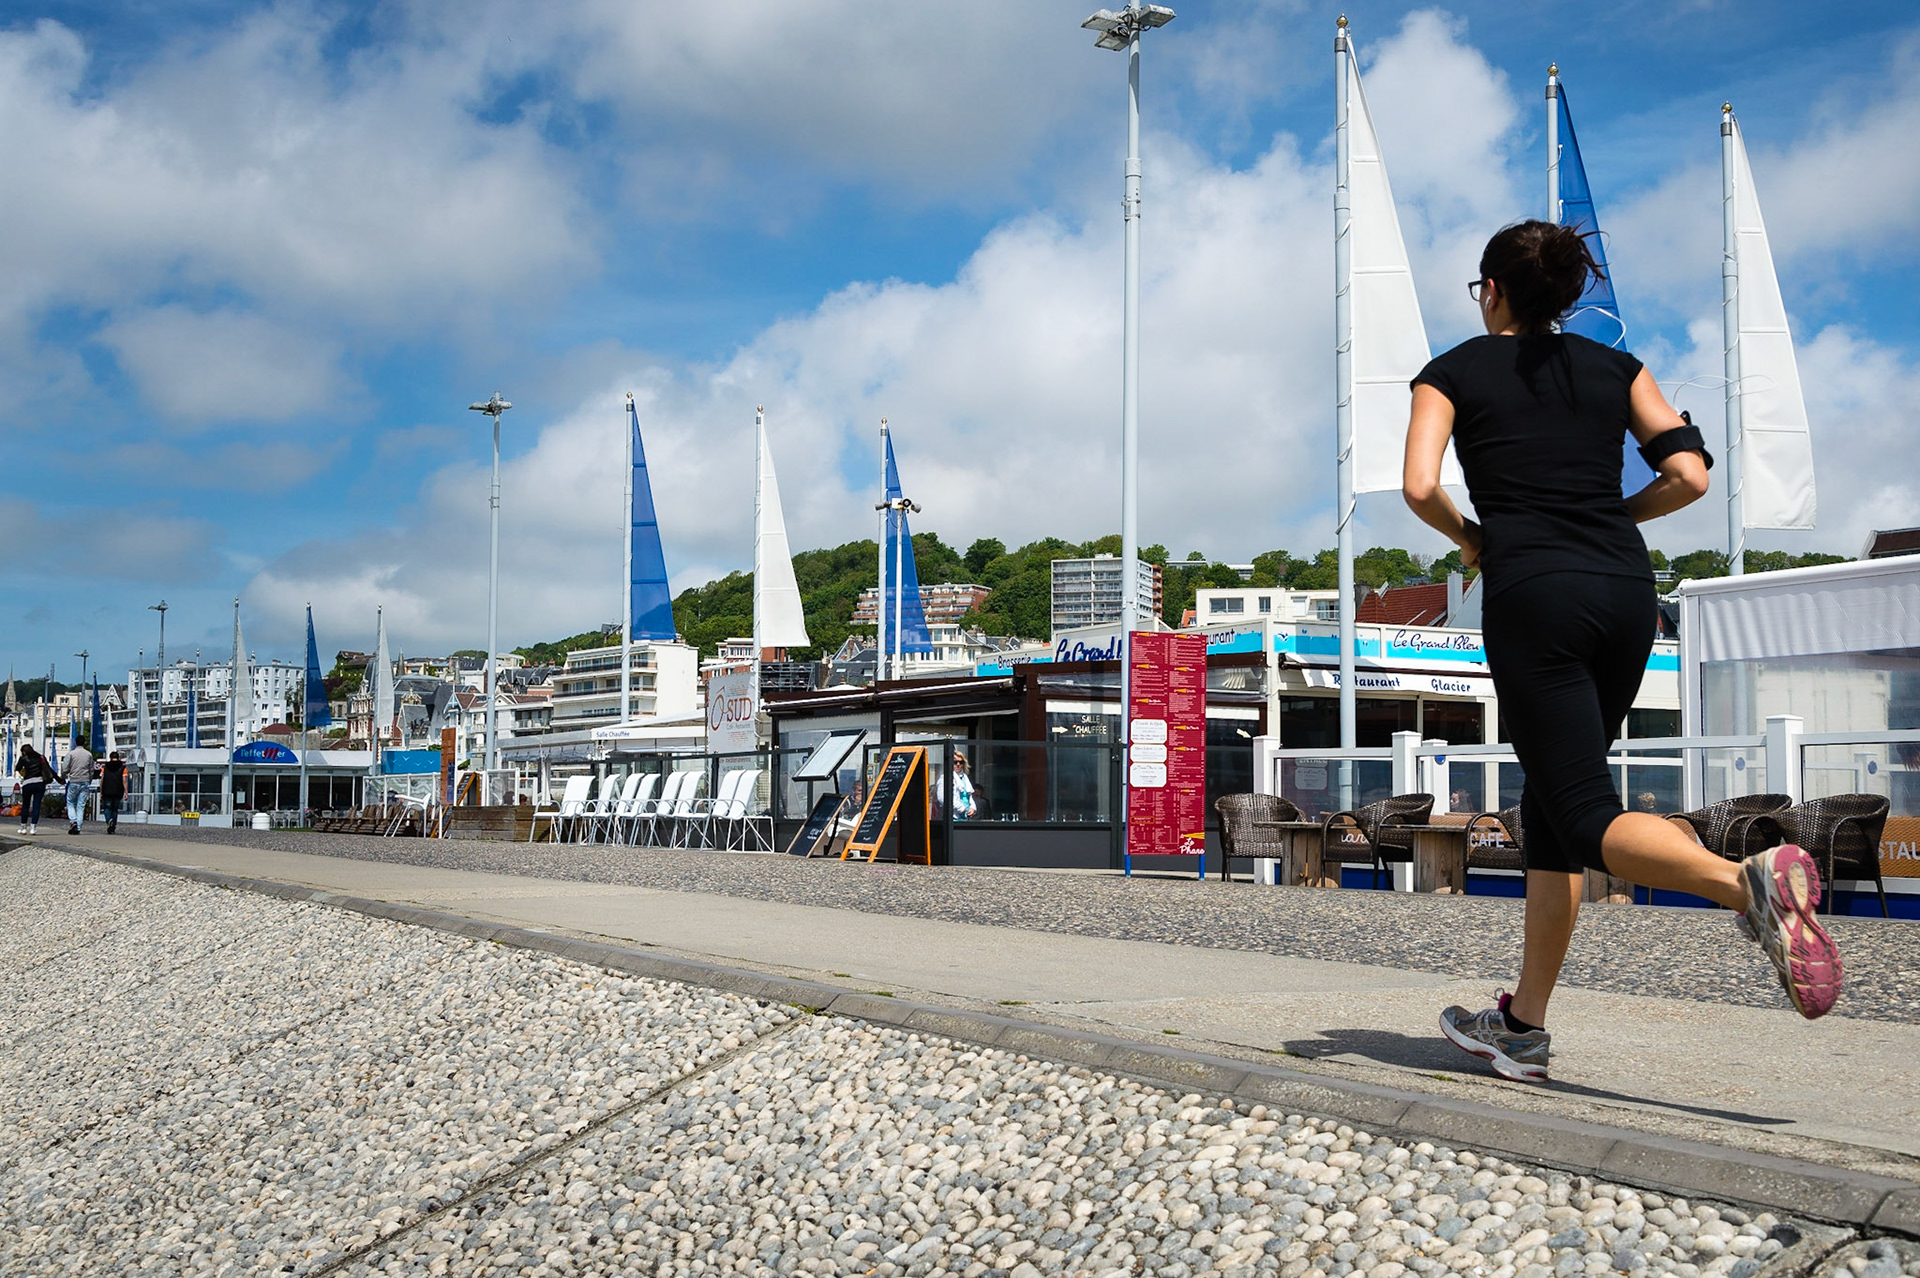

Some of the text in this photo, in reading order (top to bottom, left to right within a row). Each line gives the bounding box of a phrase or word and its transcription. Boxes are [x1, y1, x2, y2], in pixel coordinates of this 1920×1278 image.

[1055, 638, 1072, 663] Le
[1072, 636, 1115, 662] Grand
[1393, 629, 1479, 652] Le Grand Bleu
[1332, 673, 1471, 692] Rtaurant Glacier
[726, 697, 753, 722] SUD
[1081, 715, 1101, 724] SALLE
